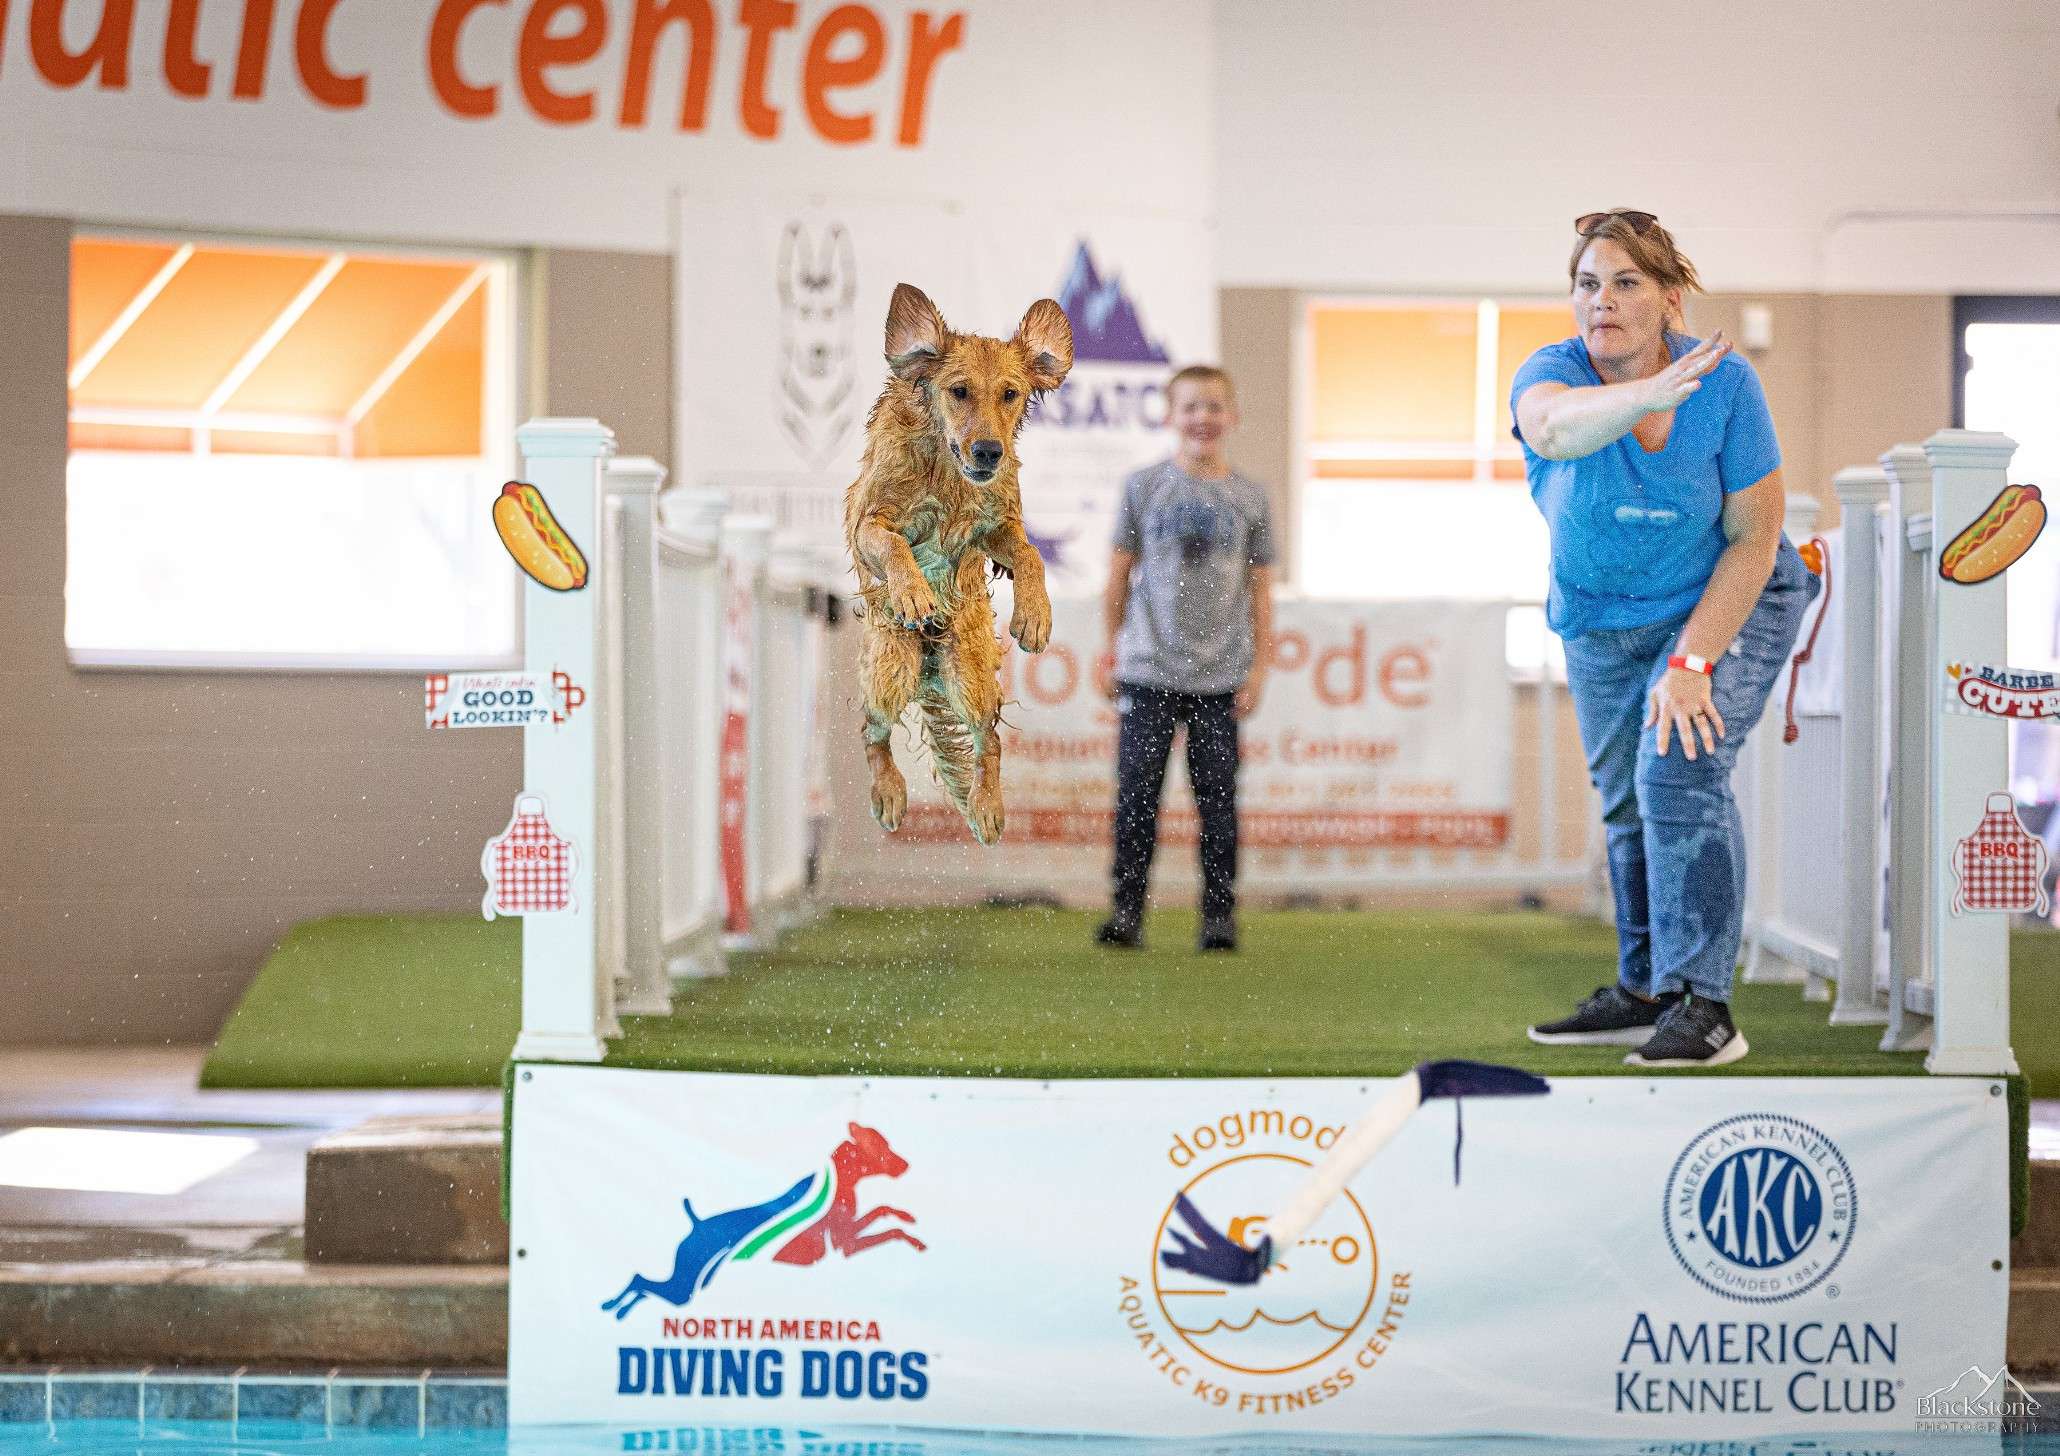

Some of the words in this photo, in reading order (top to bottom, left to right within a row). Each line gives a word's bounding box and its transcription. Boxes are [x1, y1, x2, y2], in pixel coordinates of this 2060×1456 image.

[426, 0, 966, 148] center
[452, 710, 548, 724] LOOKIN'?
[463, 690, 534, 707] GOOD
[512, 845, 549, 860] BBQ
[1980, 842, 2018, 859] BBQ
[1168, 1109, 1347, 1169] dogmod
[1679, 1126, 1747, 1221] AMERICAN
[1752, 1125, 1826, 1168] KENNEL
[1825, 1166, 1848, 1222] CLUB
[1706, 1149, 1817, 1267] AKC
[1704, 1258, 1781, 1293] FOUNDED
[1786, 1260, 1821, 1287] 1884
[662, 1317, 753, 1340] NORTH
[760, 1318, 882, 1342] AMERICA
[1119, 1275, 1190, 1386] AQUATIC
[1193, 1378, 1230, 1407] K9
[1236, 1367, 1356, 1415] FITNESS
[1355, 1271, 1413, 1370] CENTER
[1619, 1312, 1898, 1365] AMERICAN
[618, 1347, 784, 1398] DIVING
[800, 1349, 929, 1400] DOGS
[1614, 1370, 1773, 1414] KENNEL
[1786, 1371, 1897, 1414] CLUB
